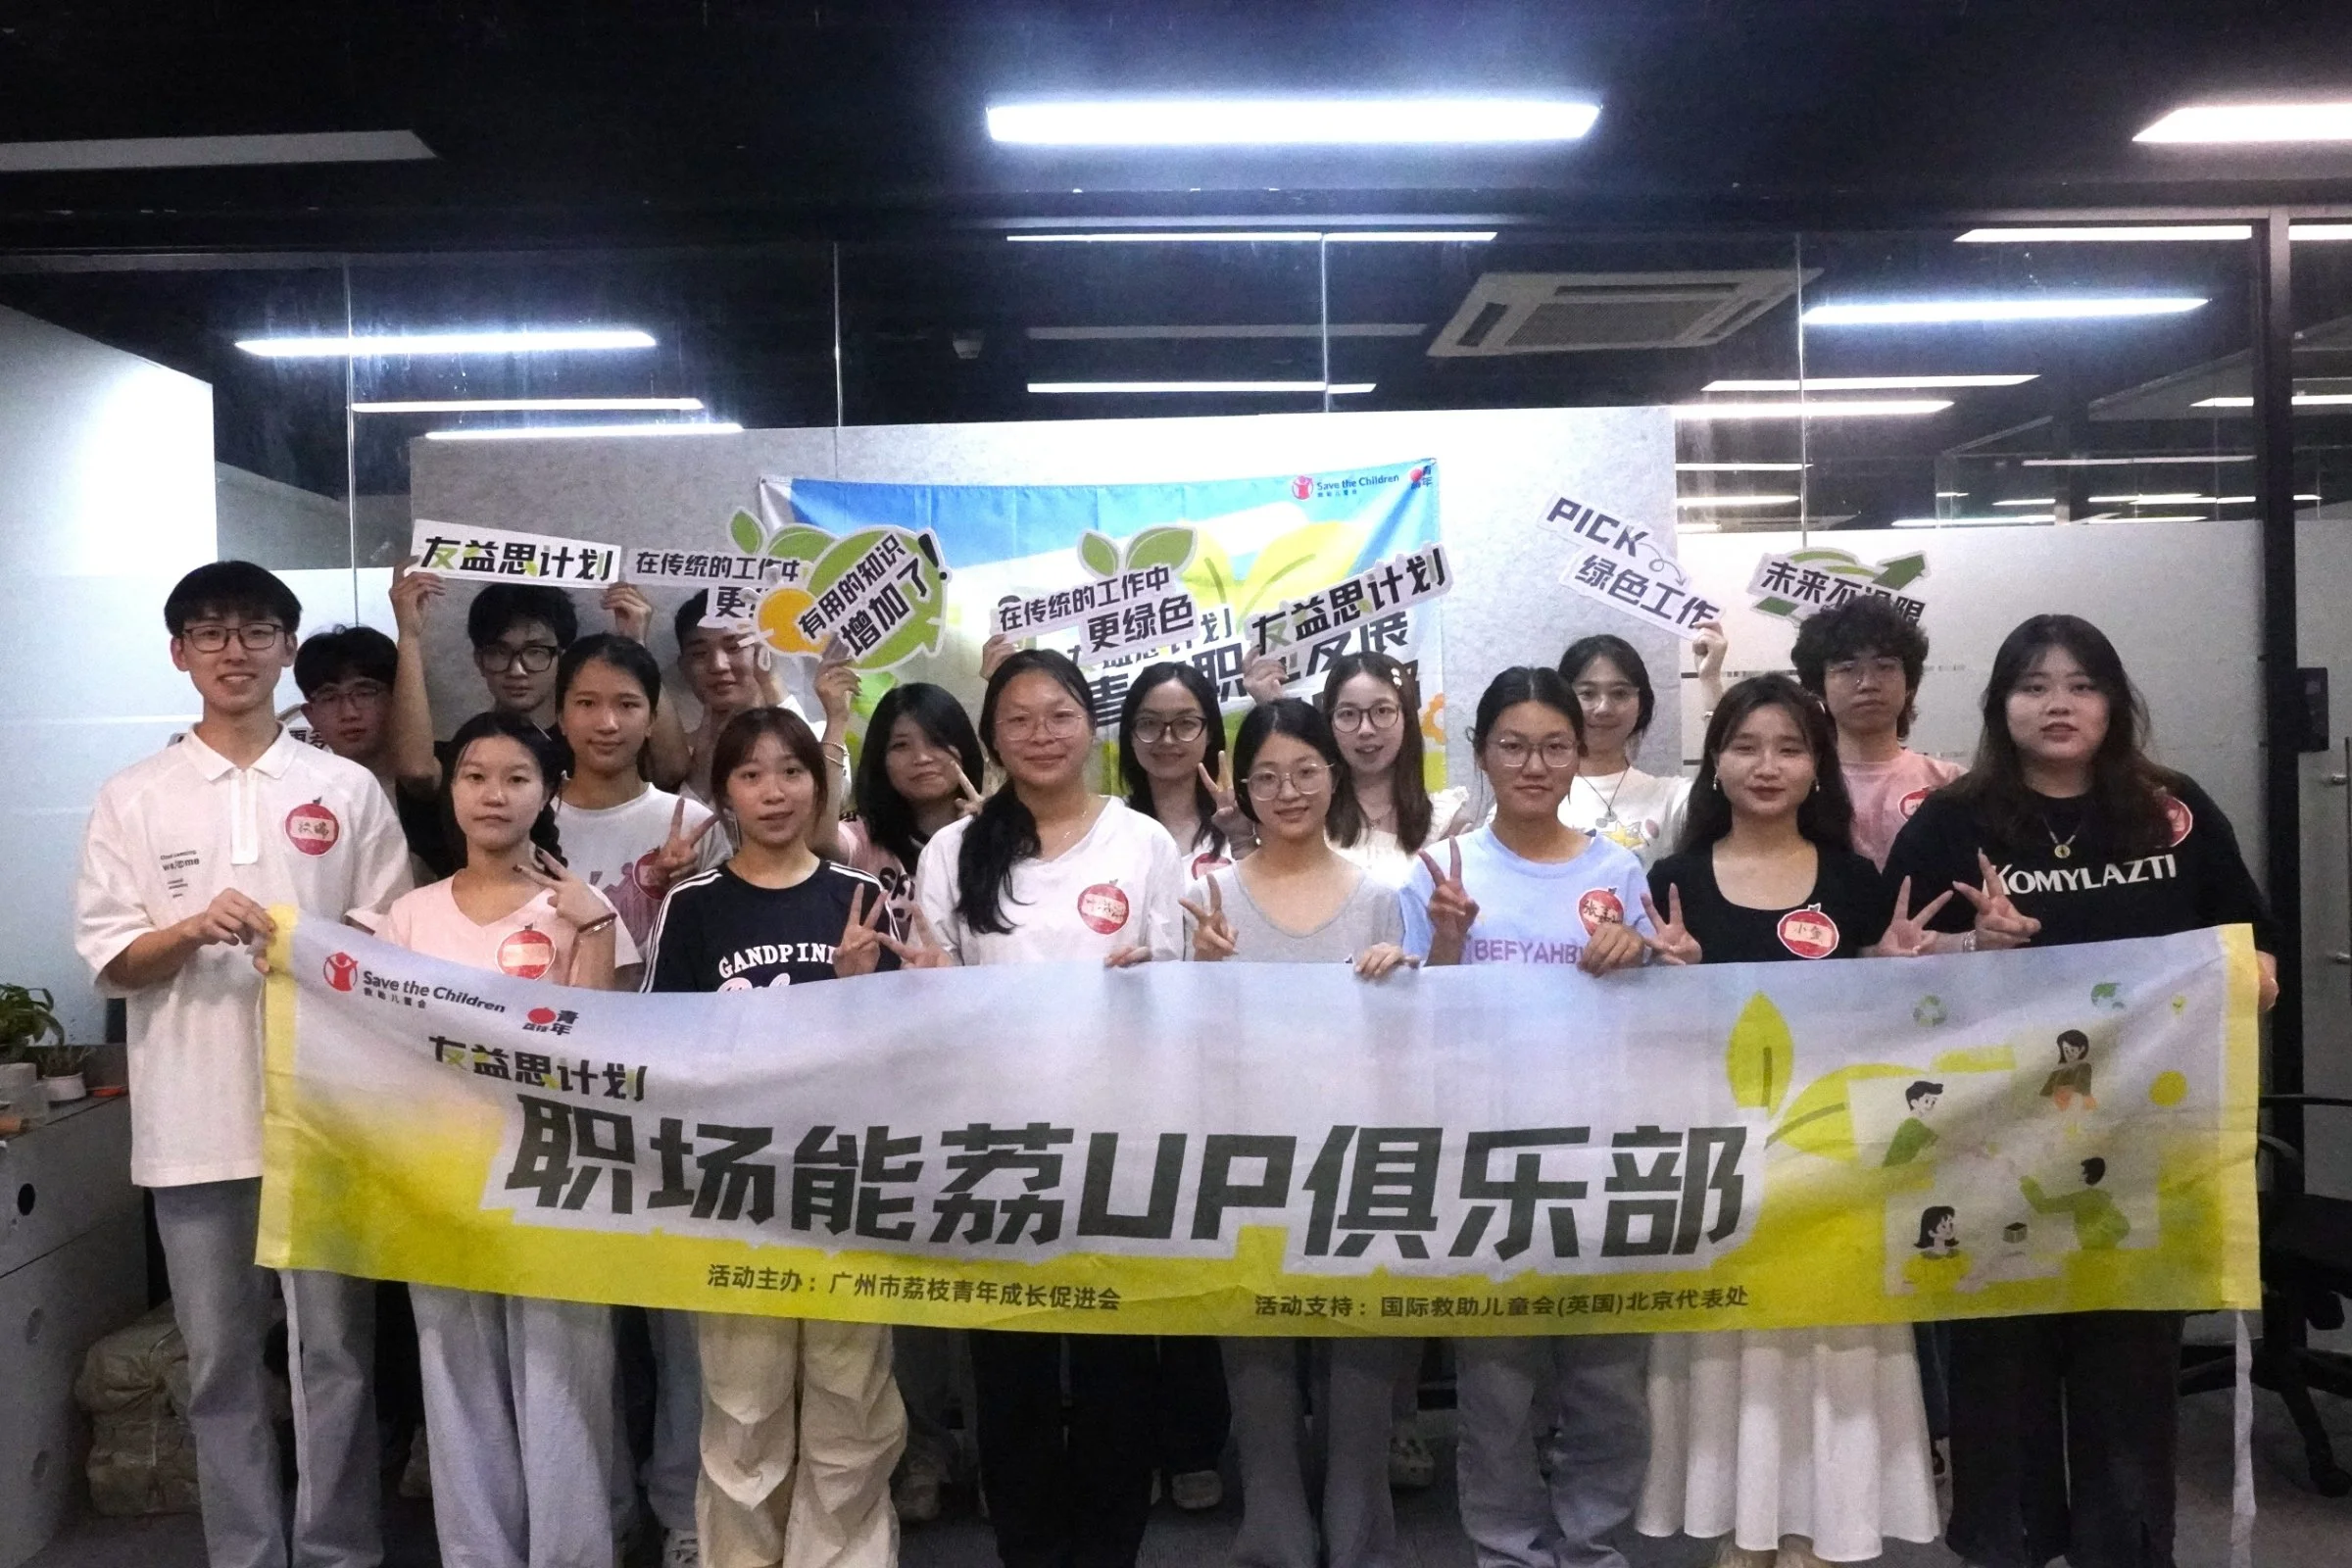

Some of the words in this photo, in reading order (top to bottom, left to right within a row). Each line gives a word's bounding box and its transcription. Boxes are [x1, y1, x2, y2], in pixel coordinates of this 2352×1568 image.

[1317, 480, 1340, 490] Save
[1342, 478, 1356, 488] the
[1358, 474, 1399, 486] Children
[1546, 497, 1649, 557] PICK
[419, 536, 614, 580] 友益思计划
[798, 534, 906, 639] 有用的知识
[999, 566, 1170, 632] 在传统的工作中
[1251, 544, 1446, 657] 友益思计划
[1575, 555, 1719, 630] 绿色工作
[1087, 596, 1195, 654] 更绿色
[1983, 854, 2177, 898] KOMYLAZTI
[1474, 939, 1585, 964] BEFYAHB
[363, 970, 399, 992] Save
[402, 981, 430, 997] the
[433, 986, 506, 1013] Children
[428, 1035, 649, 1102] 友益思计划
[505, 1093, 1747, 1262] 职场能荔UP俱乐部
